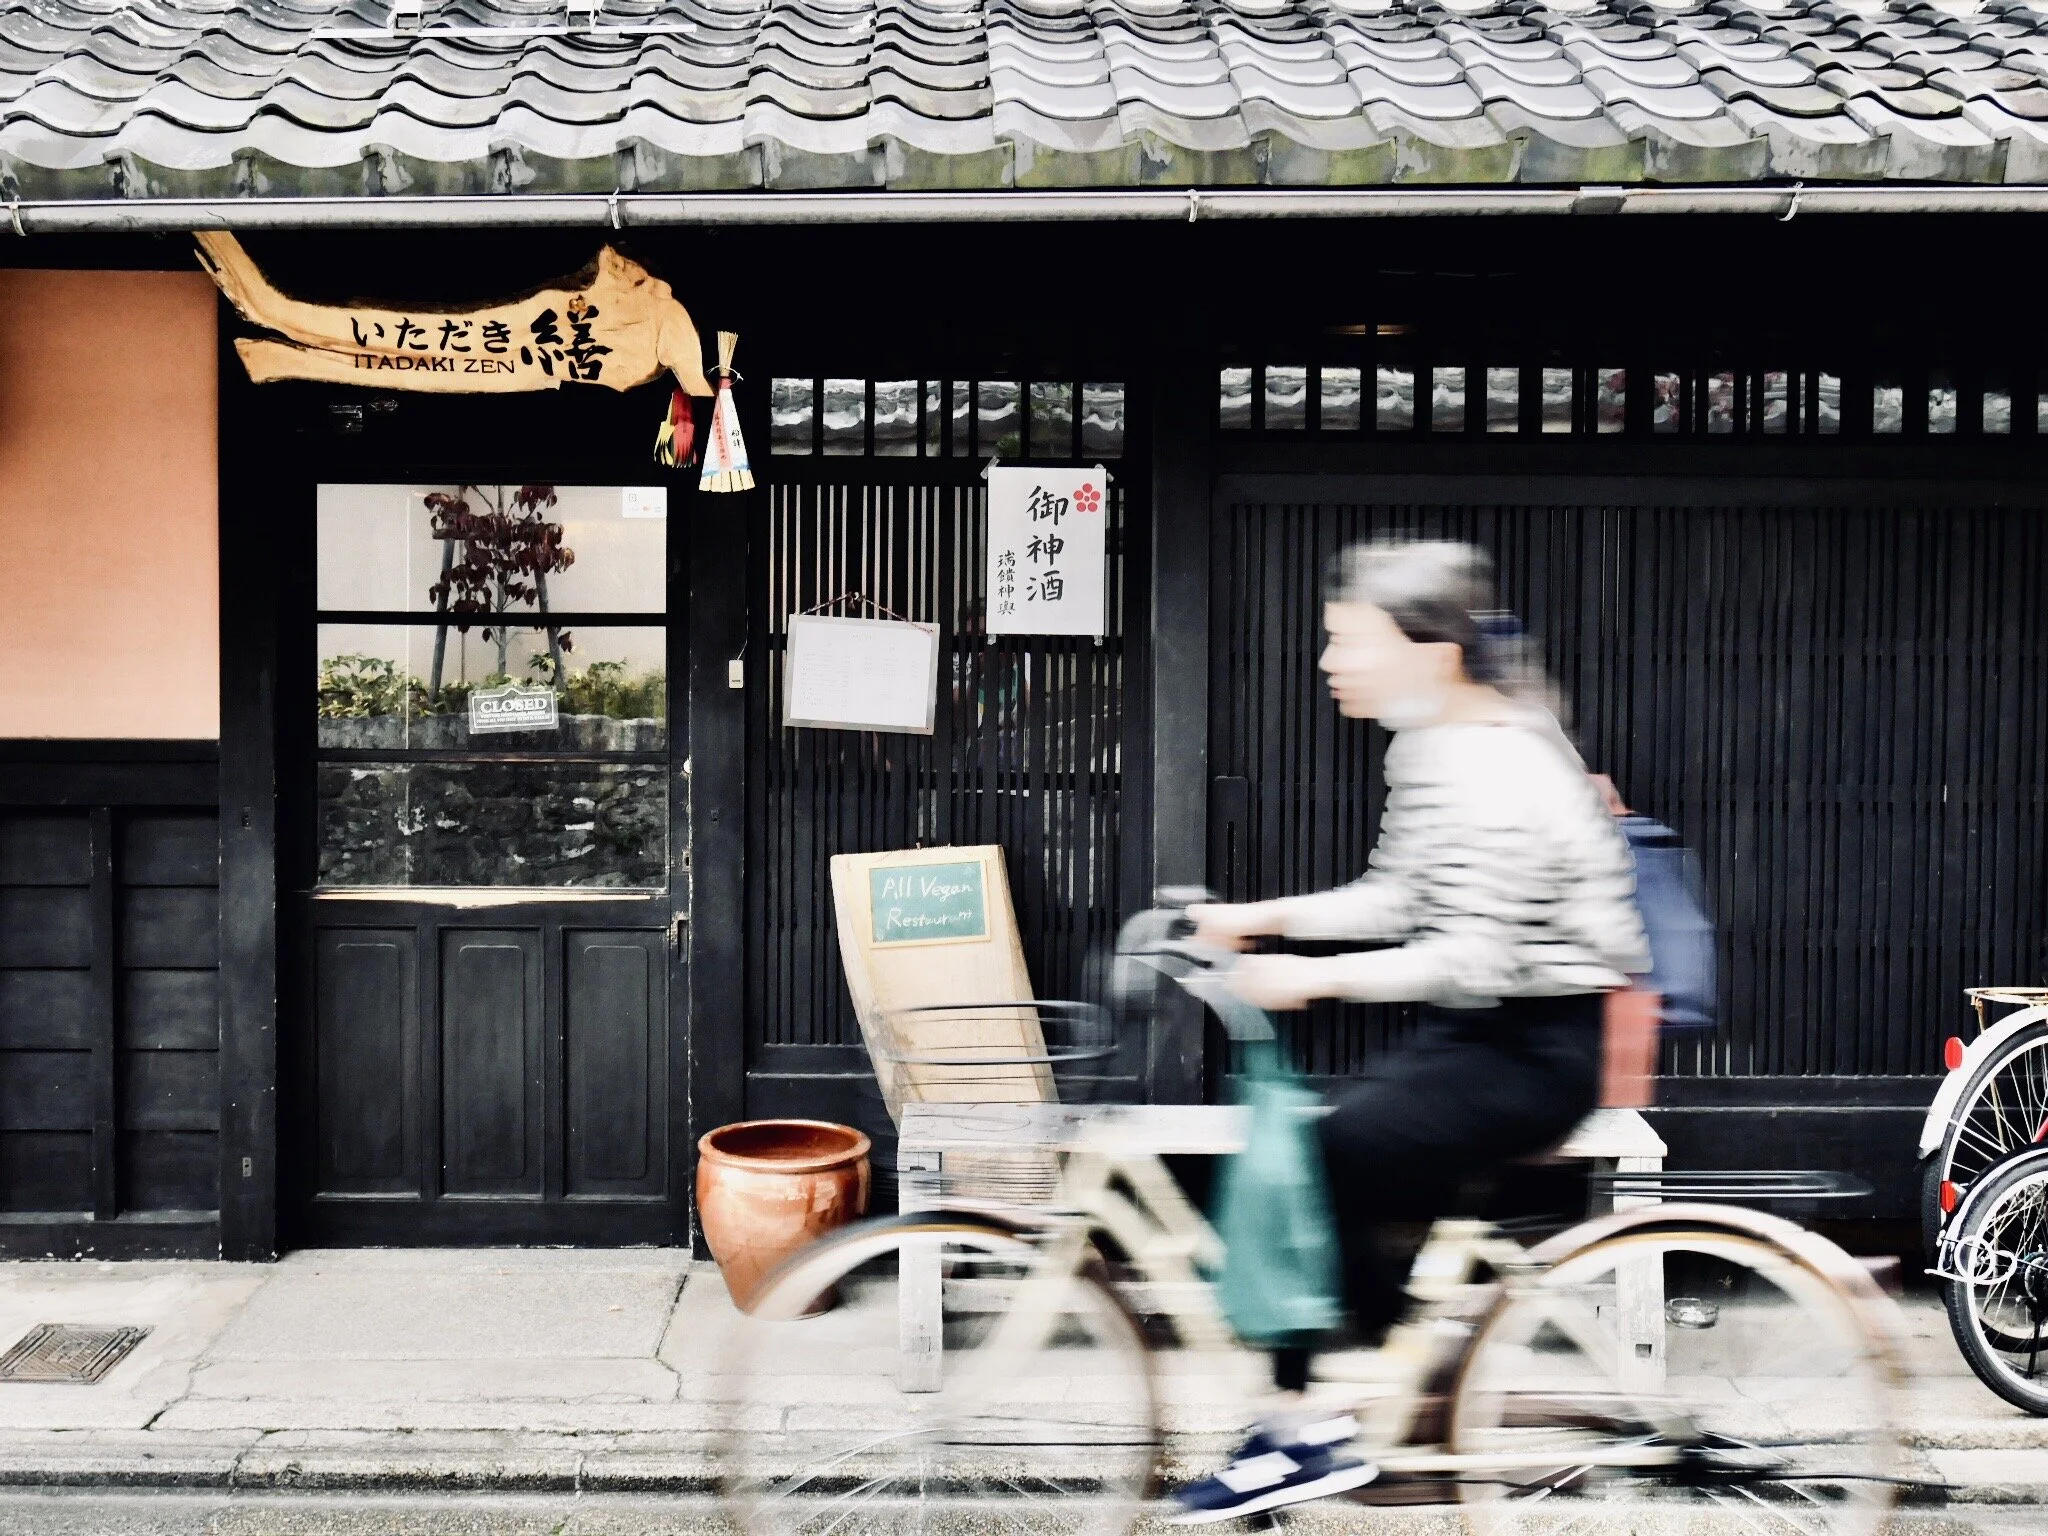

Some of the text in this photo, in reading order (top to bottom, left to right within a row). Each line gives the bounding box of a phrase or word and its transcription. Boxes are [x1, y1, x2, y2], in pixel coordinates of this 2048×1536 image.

[354, 353, 516, 375] ITADAKI ZEN
[1025, 485, 1070, 602] 御神酒
[480, 697, 548, 714] CLOSED
[881, 875, 975, 903] All Vegan
